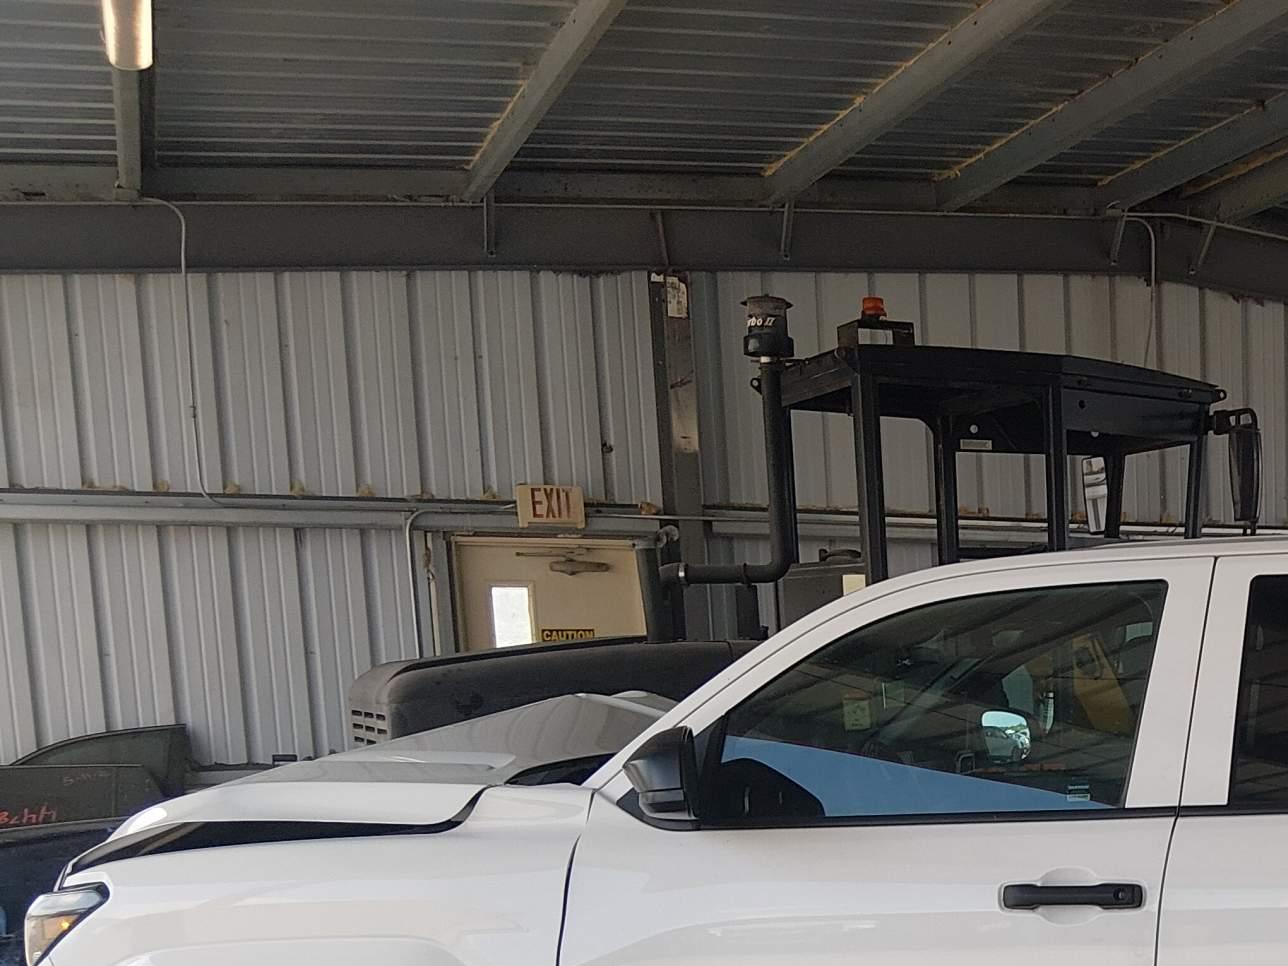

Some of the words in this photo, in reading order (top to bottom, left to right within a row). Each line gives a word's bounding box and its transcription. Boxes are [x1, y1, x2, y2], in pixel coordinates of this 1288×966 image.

[747, 316, 763, 327] rbo
[530, 487, 573, 519] EXIT
[543, 630, 593, 641] CAUTION
